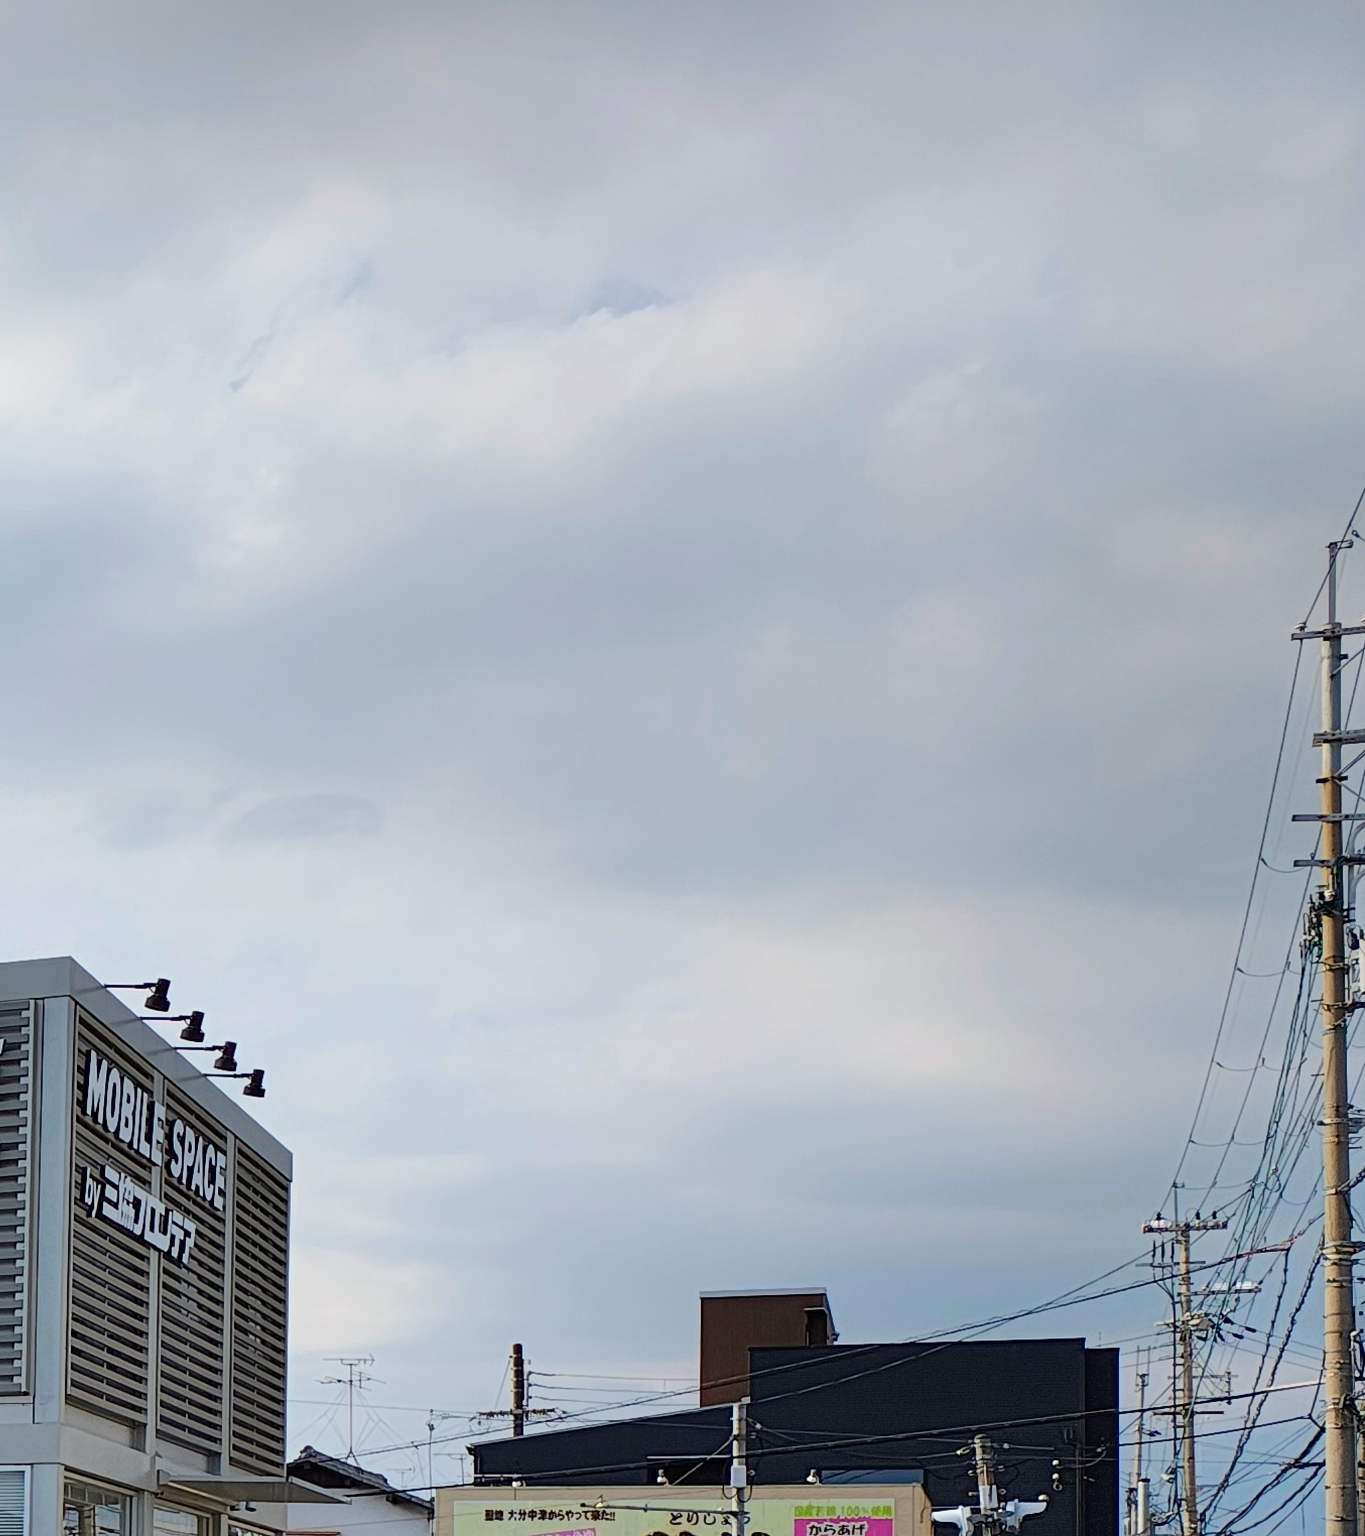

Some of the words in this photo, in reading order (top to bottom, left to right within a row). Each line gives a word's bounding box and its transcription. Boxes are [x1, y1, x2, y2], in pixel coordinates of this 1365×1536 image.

[84, 1049, 166, 1167] MOBILE
[170, 1119, 227, 1211] SPACE
[83, 1167, 102, 1218] by
[809, 1524, 866, 1536] からあげ
